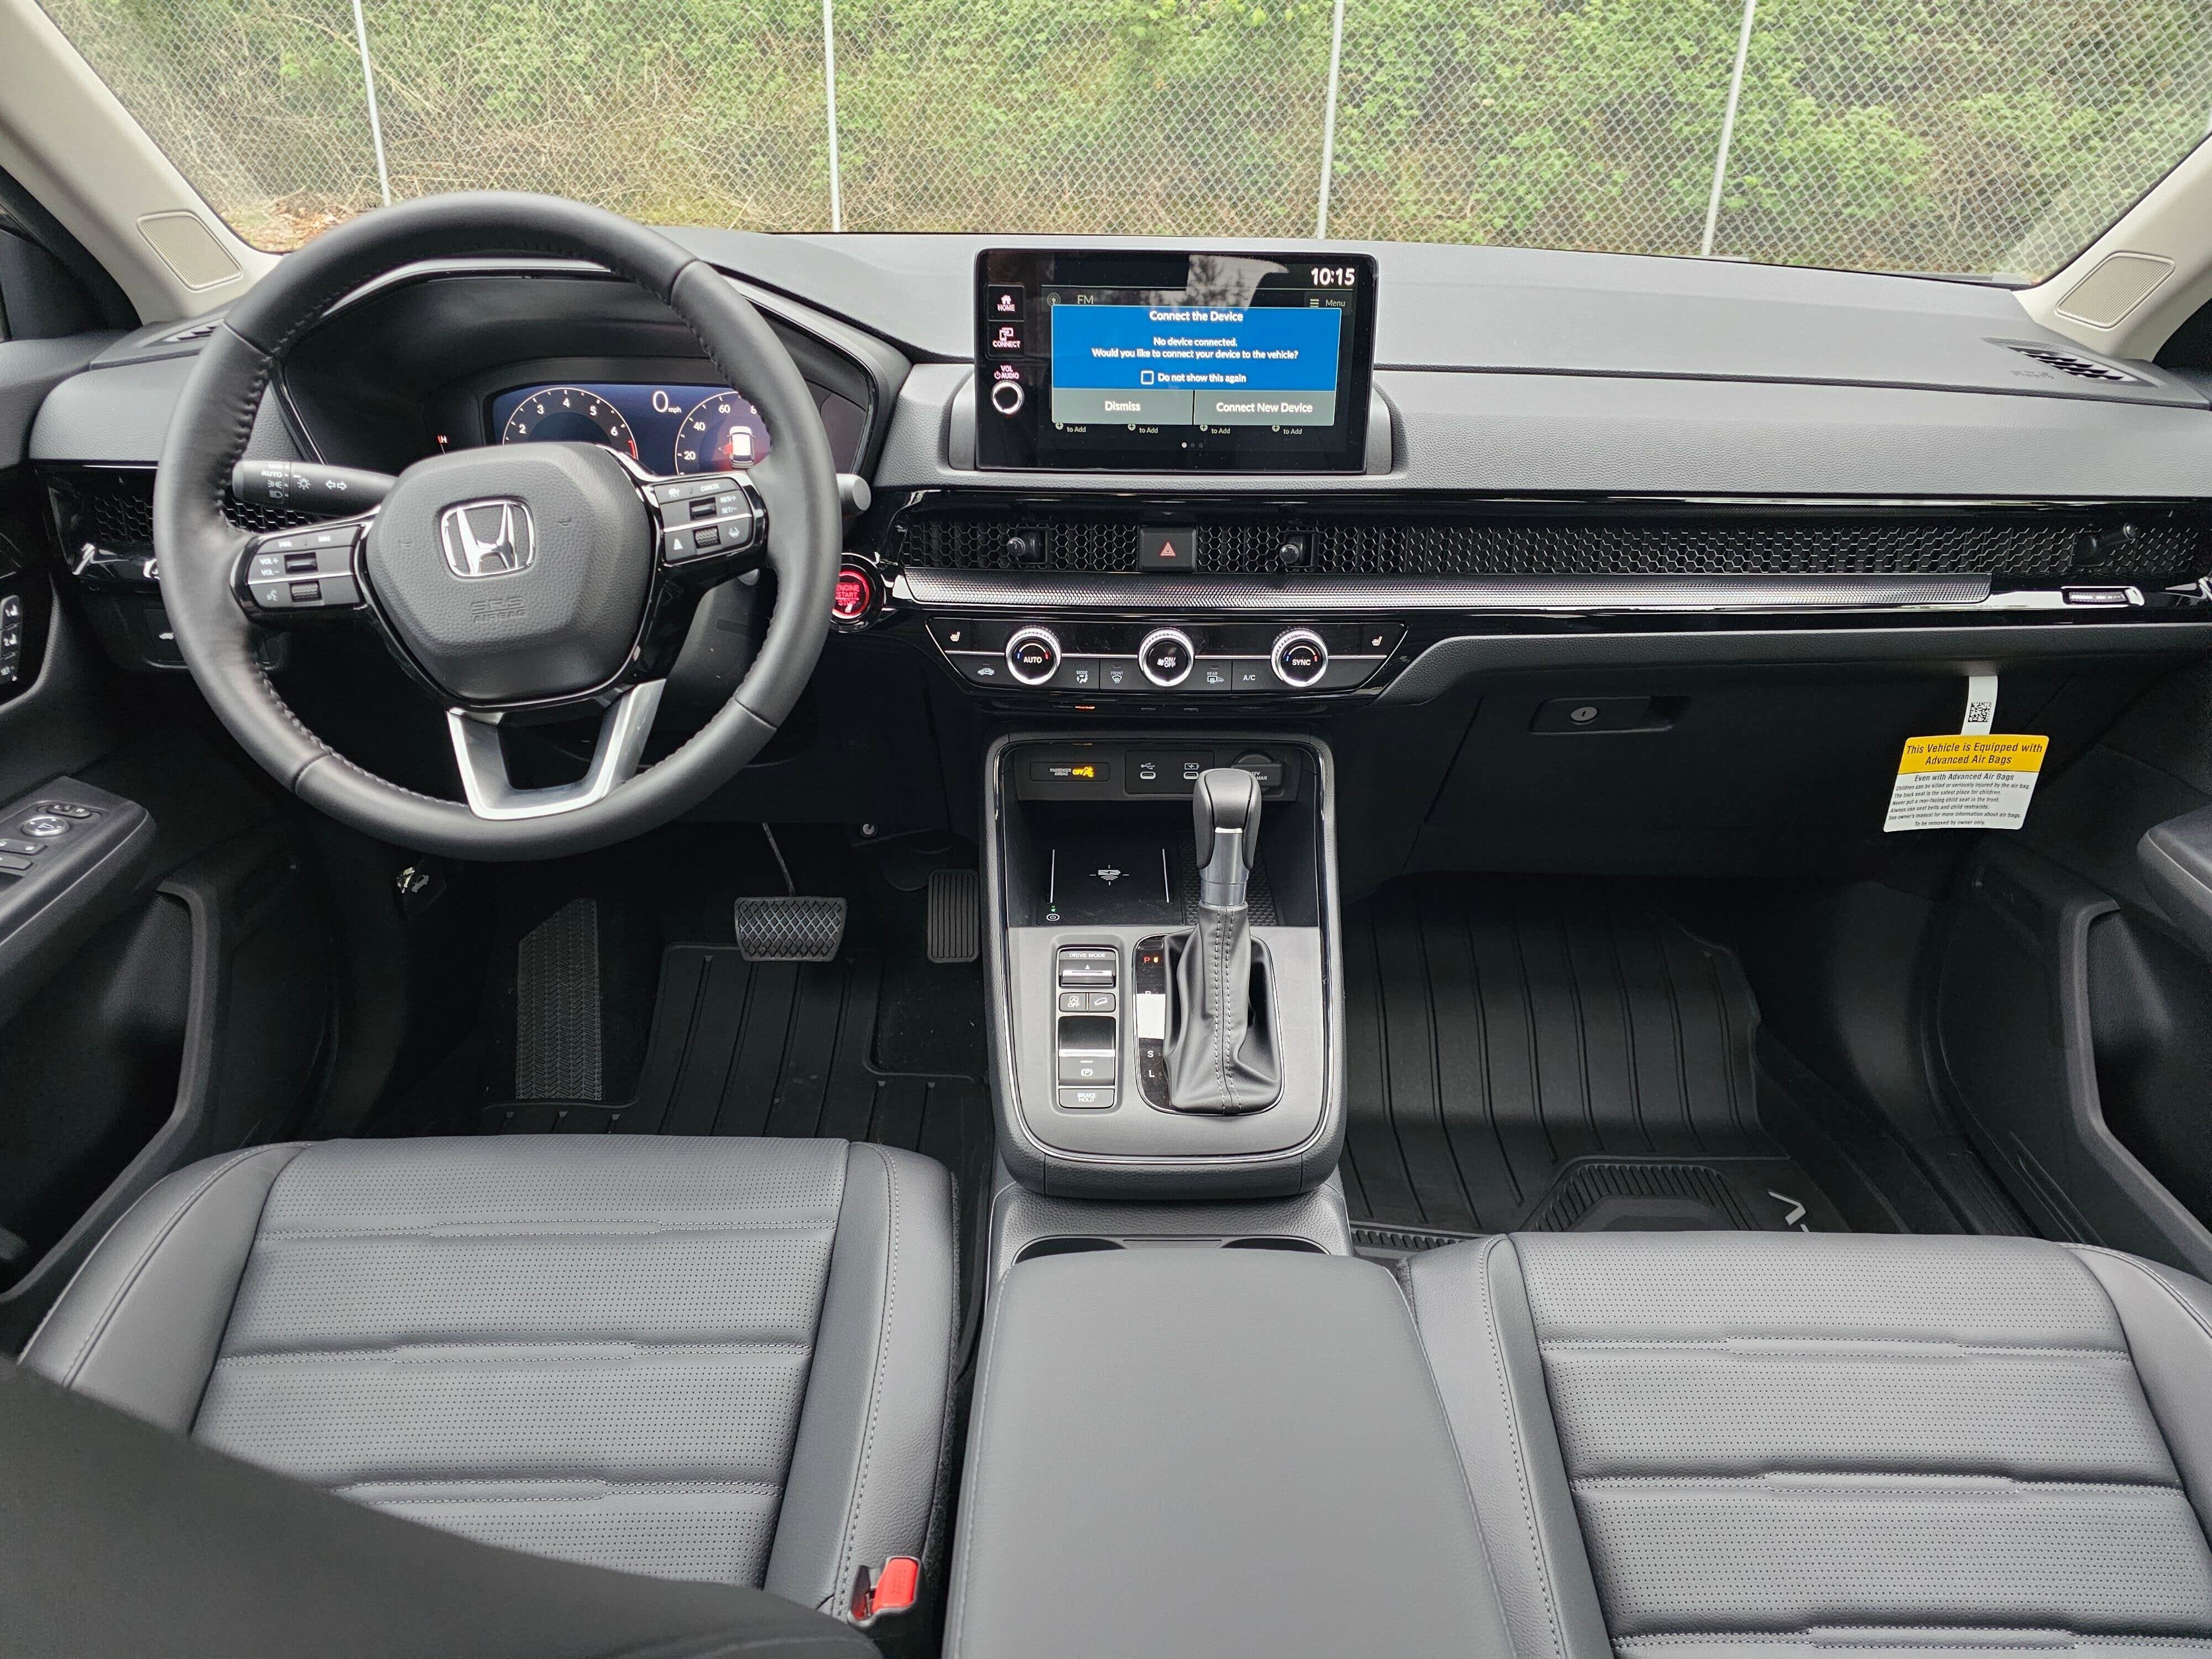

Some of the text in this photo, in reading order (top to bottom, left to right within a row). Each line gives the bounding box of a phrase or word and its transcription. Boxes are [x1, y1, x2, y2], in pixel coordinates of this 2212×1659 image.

[1311, 267, 1355, 286] 10:15
[1077, 295, 1093, 305] FM
[1149, 310, 1243, 322] Connect the Device
[1153, 337, 1237, 347] No device connected.
[1092, 348, 1298, 359] Would you like to connect your device to the vehicle?
[1158, 373, 1246, 384] Do not show this again
[563, 398, 571, 408] 4
[653, 390, 669, 413] 0
[1105, 401, 1140, 411] Dismiss
[537, 405, 544, 414] 3
[589, 406, 597, 416] 5
[718, 404, 731, 414] 60
[1217, 402, 1313, 413] Connect New Device
[519, 424, 526, 434] 2
[611, 426, 618, 436] 6
[693, 422, 706, 431] 40
[684, 451, 696, 460] 20
[261, 469, 283, 478] AUTO
[700, 483, 720, 492] CANCEL
[1907, 743, 2042, 754] This Vehicle is Equipped with
[1926, 755, 2012, 765] Advanced Air Bags
